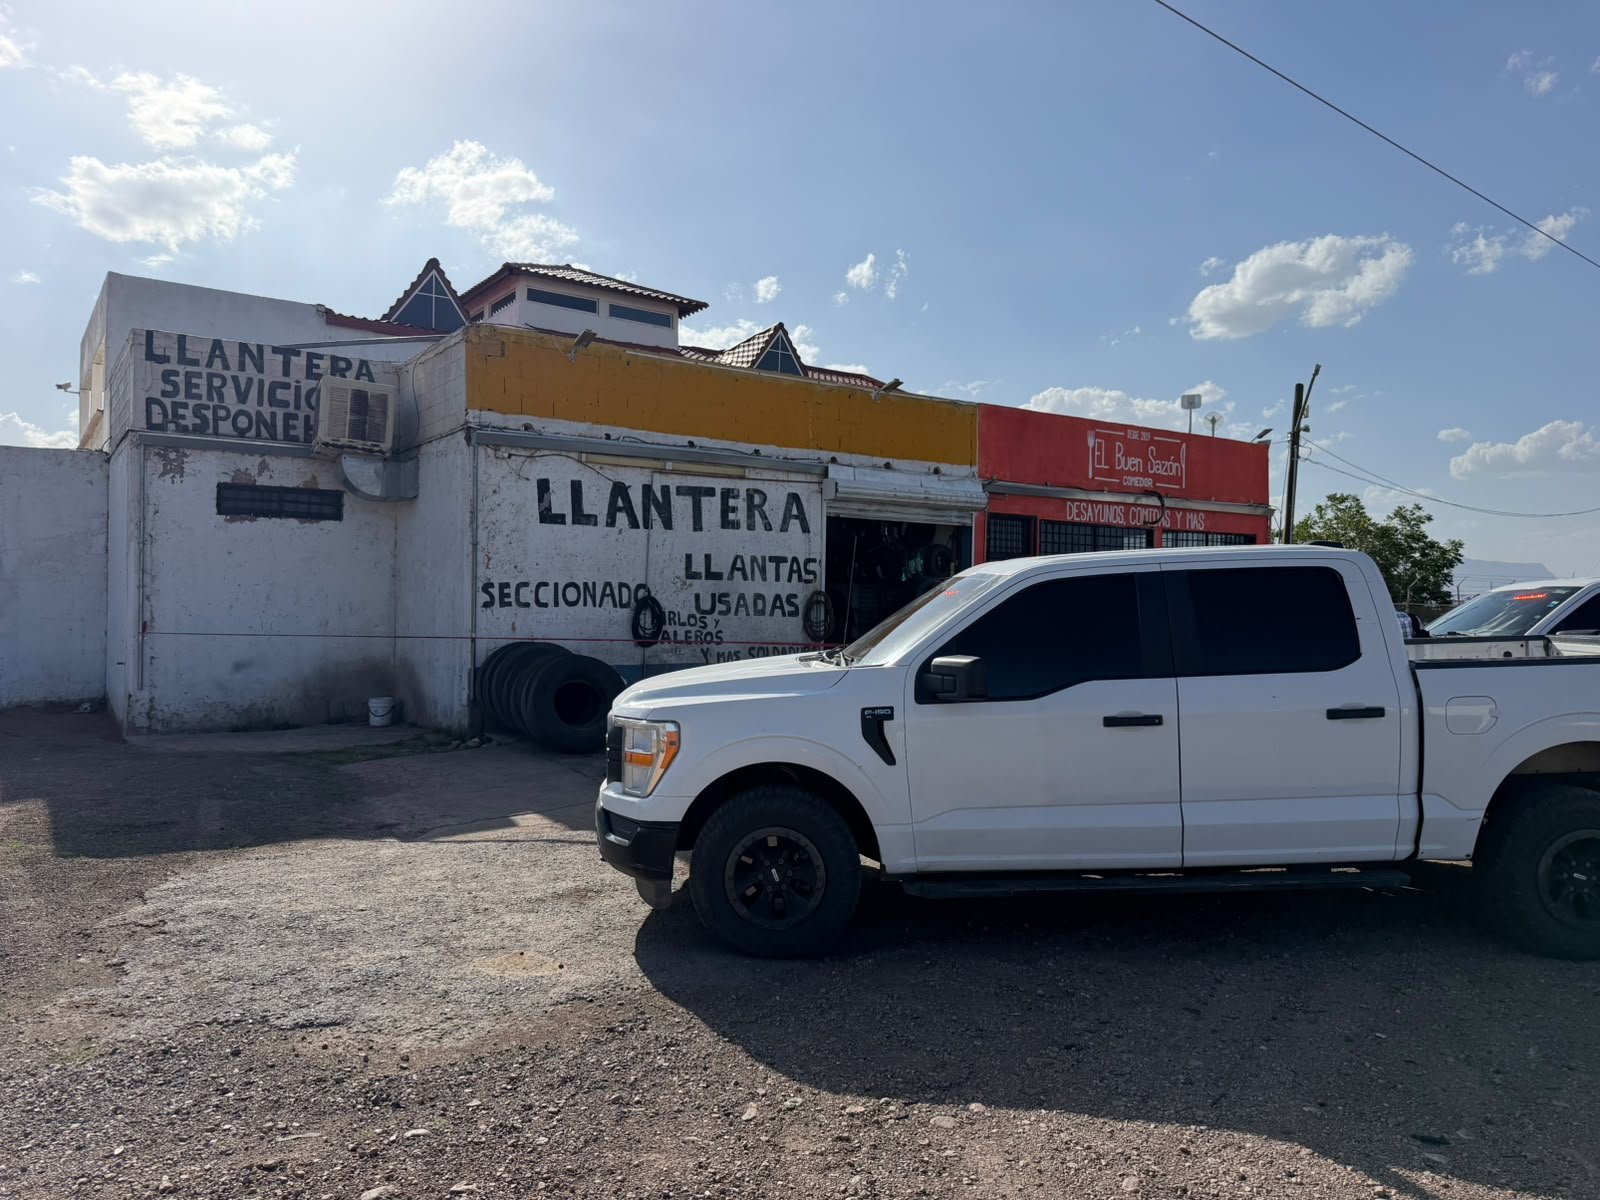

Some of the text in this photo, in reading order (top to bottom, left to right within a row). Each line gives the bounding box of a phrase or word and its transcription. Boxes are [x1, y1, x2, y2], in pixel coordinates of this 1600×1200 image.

[145, 330, 375, 382] LLANTERA
[1115, 442, 1143, 473] Buen
[1148, 446, 1181, 477] Sazón
[1122, 475, 1153, 488] COMEDOR
[536, 478, 811, 534] LLANTERA
[1066, 501, 1205, 530] DESAYUNOS, COMIDAS Y MAS
[685, 553, 818, 584] LLANTAS
[481, 581, 652, 609] SECCIONADO
[694, 592, 800, 618] USADAS
[660, 630, 723, 645] ALEROS
[700, 647, 710, 665] Y
[716, 650, 741, 663] MAS
